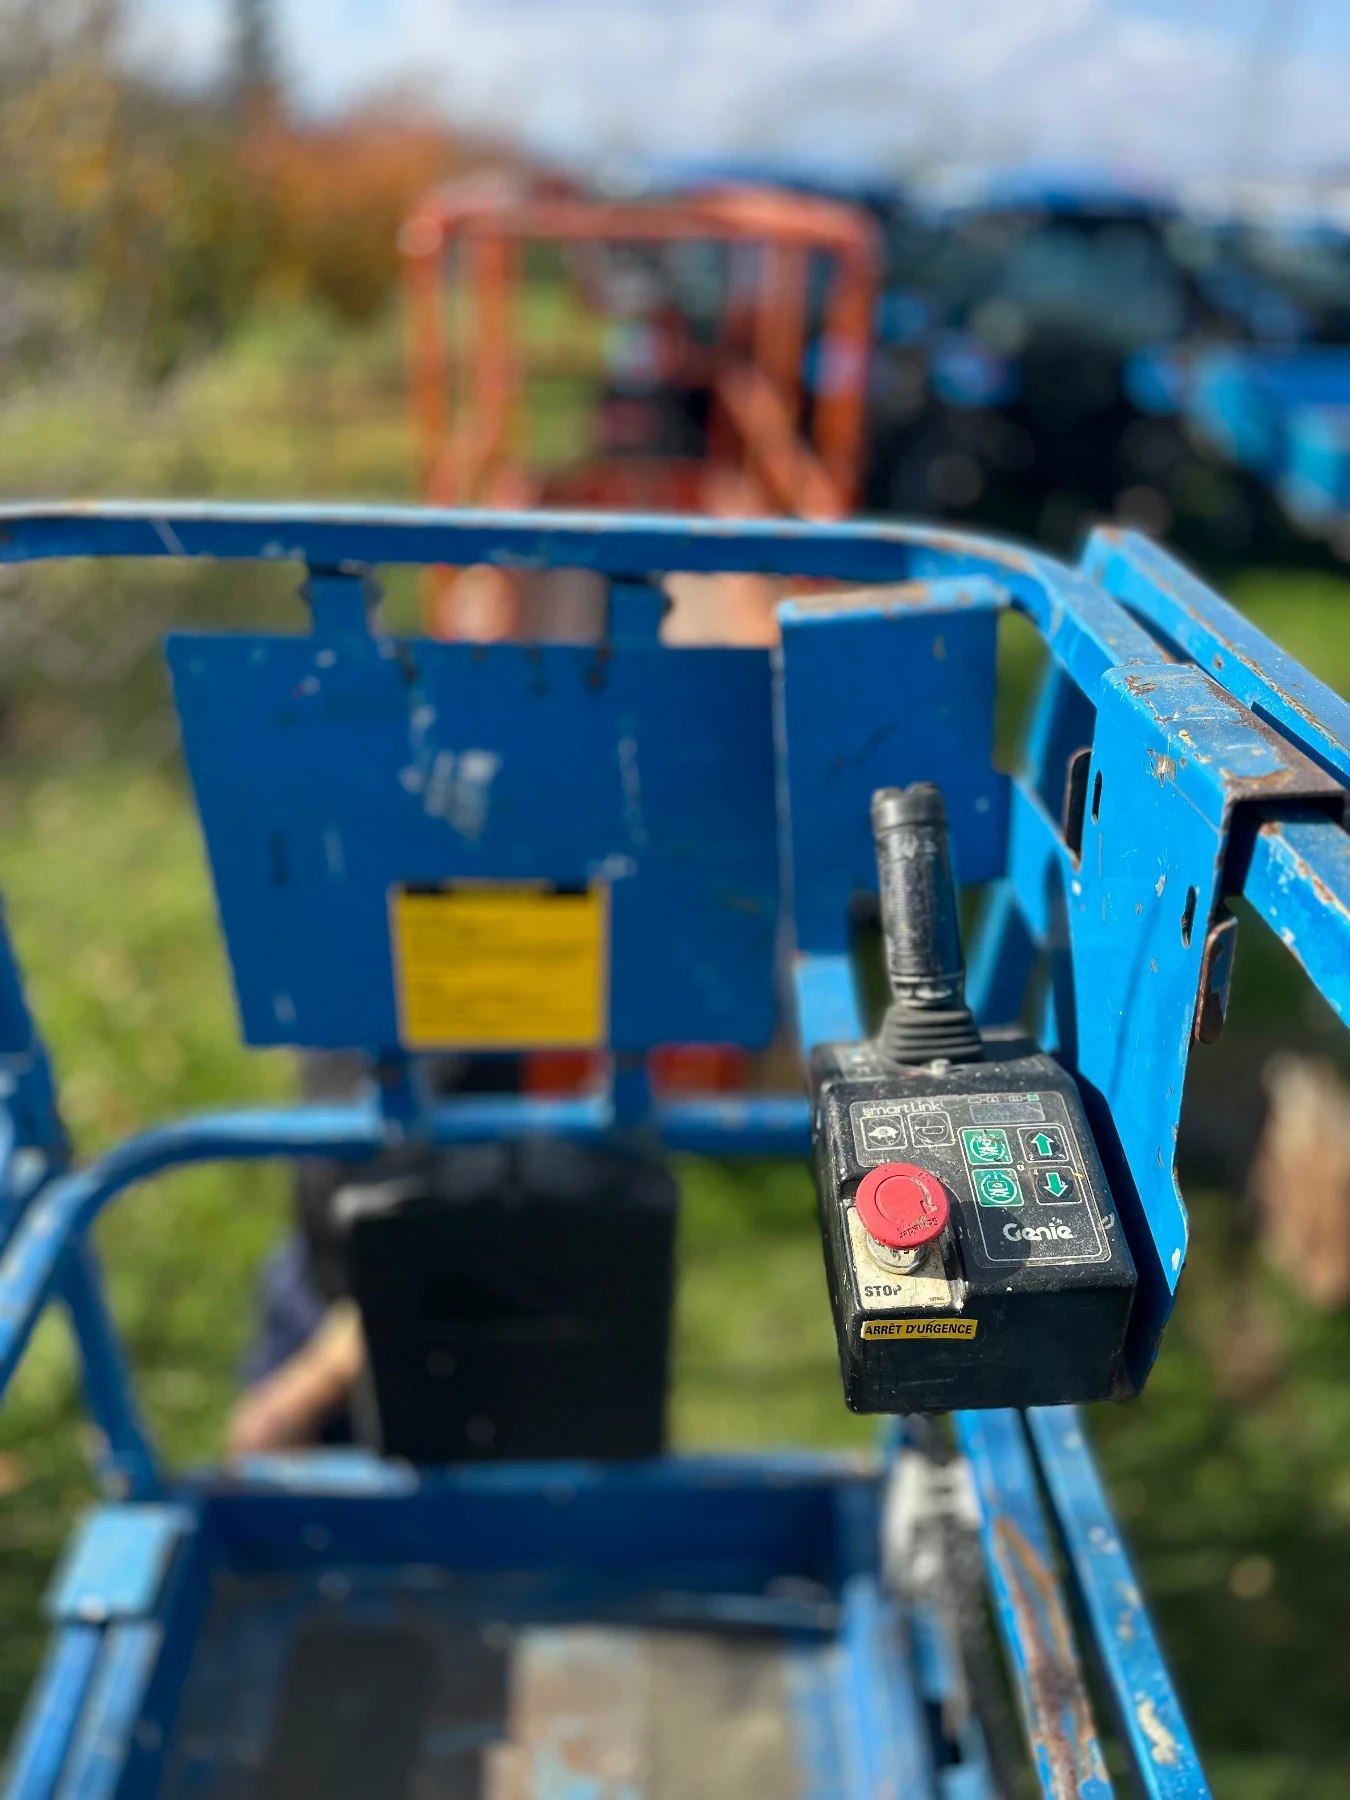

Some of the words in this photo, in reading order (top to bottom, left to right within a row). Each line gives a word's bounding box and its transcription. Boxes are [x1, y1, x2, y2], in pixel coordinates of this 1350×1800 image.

[862, 1103, 909, 1116] smart
[910, 1101, 941, 1113] Link
[1028, 1153, 1034, 1161] 2
[1002, 1222, 1074, 1242] Genie
[864, 1284, 903, 1297] STOP
[864, 1322, 903, 1335] ARRÊT
[905, 1322, 974, 1335] D'URGENCE
